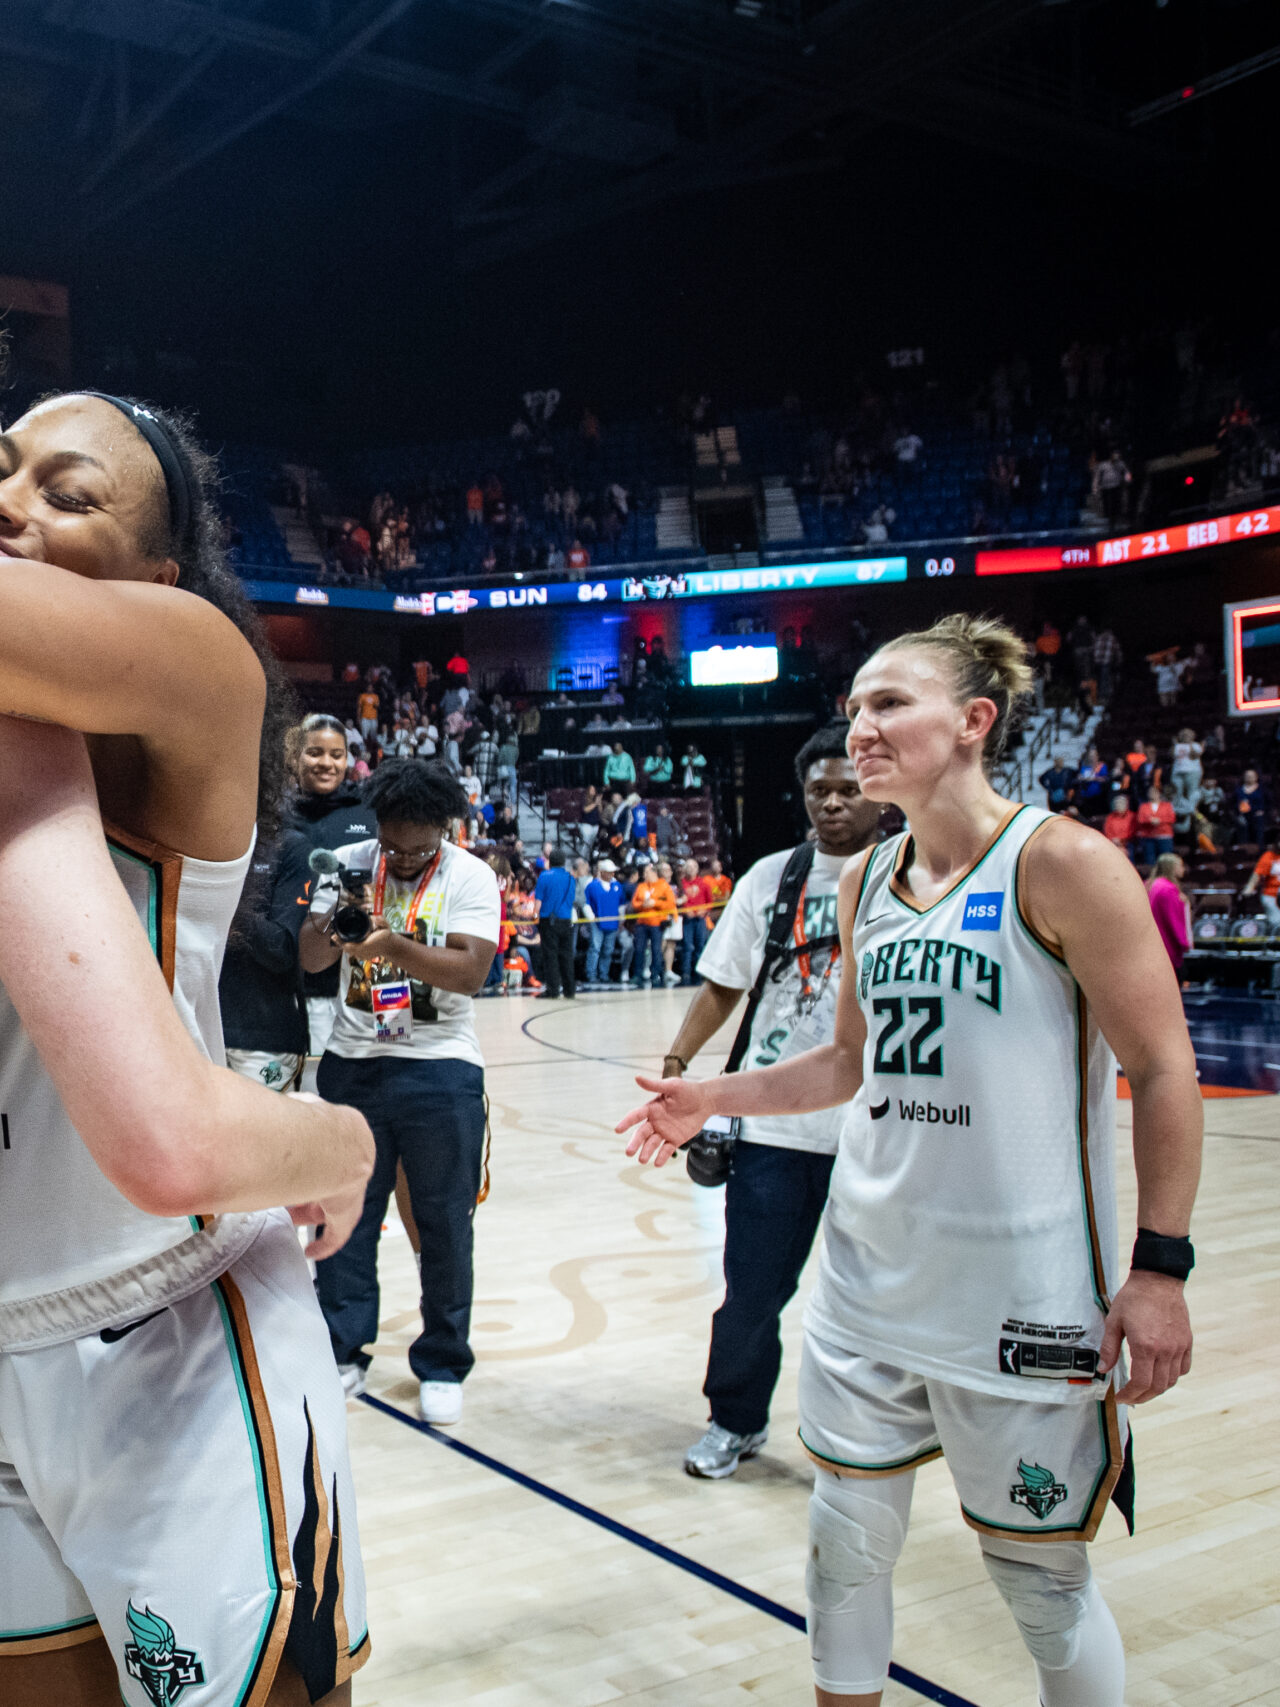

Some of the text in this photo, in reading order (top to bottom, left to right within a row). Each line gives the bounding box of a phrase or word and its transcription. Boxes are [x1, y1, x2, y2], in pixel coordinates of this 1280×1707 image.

[1062, 512, 1270, 564] 4TH AST 21 REB 42
[696, 562, 887, 593] LIBERTY 87
[925, 558, 956, 577] 0.0
[489, 583, 608, 608] SUN 84
[966, 904, 998, 918] HSS
[872, 996, 944, 1077] 22
[898, 1100, 971, 1127] Webull
